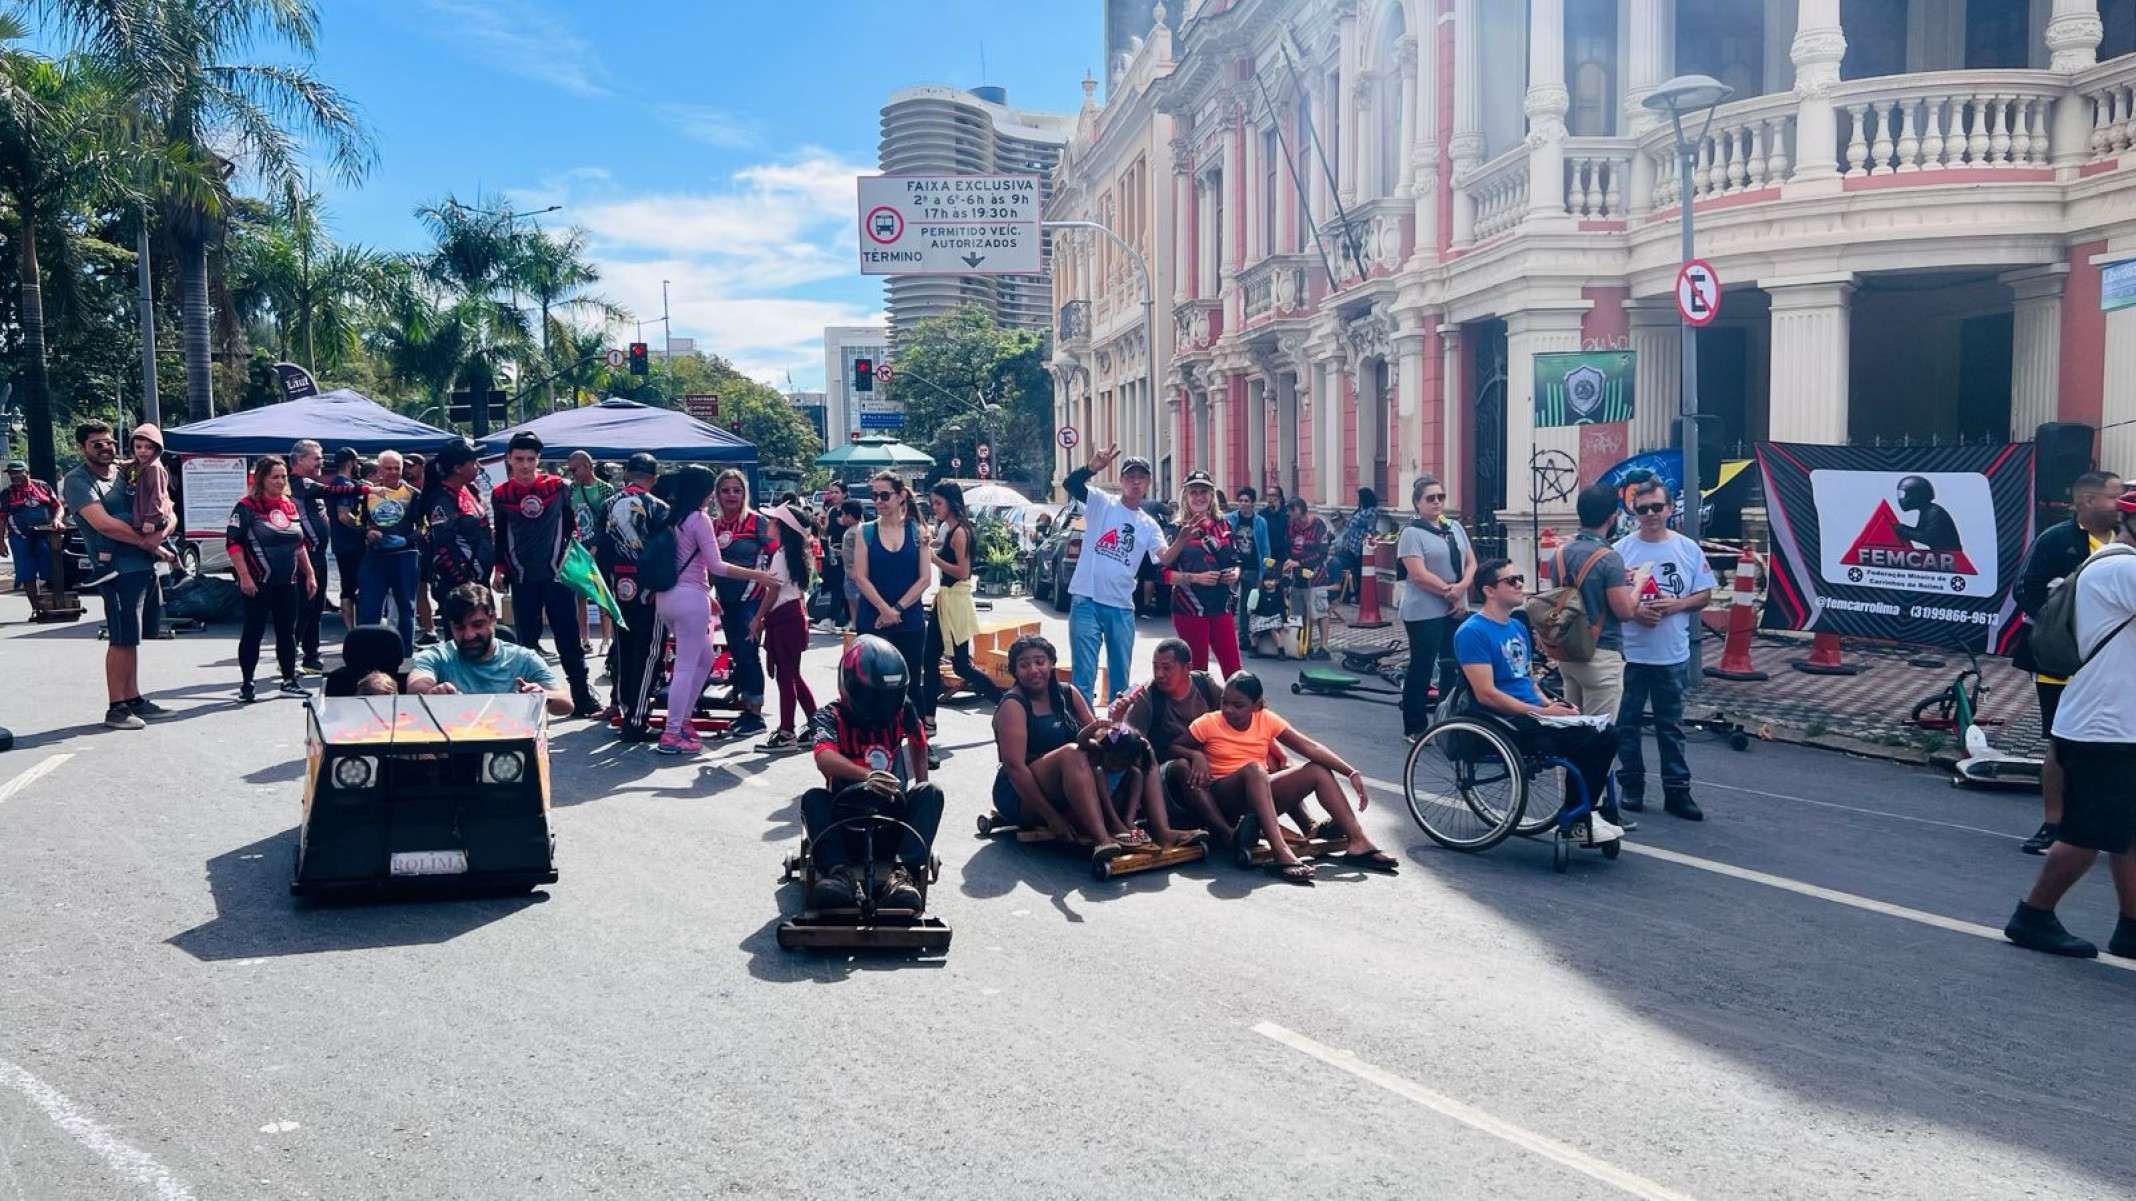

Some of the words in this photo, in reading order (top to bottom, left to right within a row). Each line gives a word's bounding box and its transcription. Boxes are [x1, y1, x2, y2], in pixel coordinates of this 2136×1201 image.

[906, 180, 950, 192] FAIXA
[955, 179, 1034, 192] EXCLUSIVA
[933, 197, 941, 205] a
[1011, 194, 1029, 205] 9h
[924, 207, 948, 219] 17h
[920, 226, 986, 237] PERMITIDO
[930, 238, 1017, 249] AUTORIZADOS
[863, 248, 923, 263] TÉRMINO
[1857, 548, 1955, 570] FEMCAR
[1815, 595, 1901, 616] @femcarrolima
